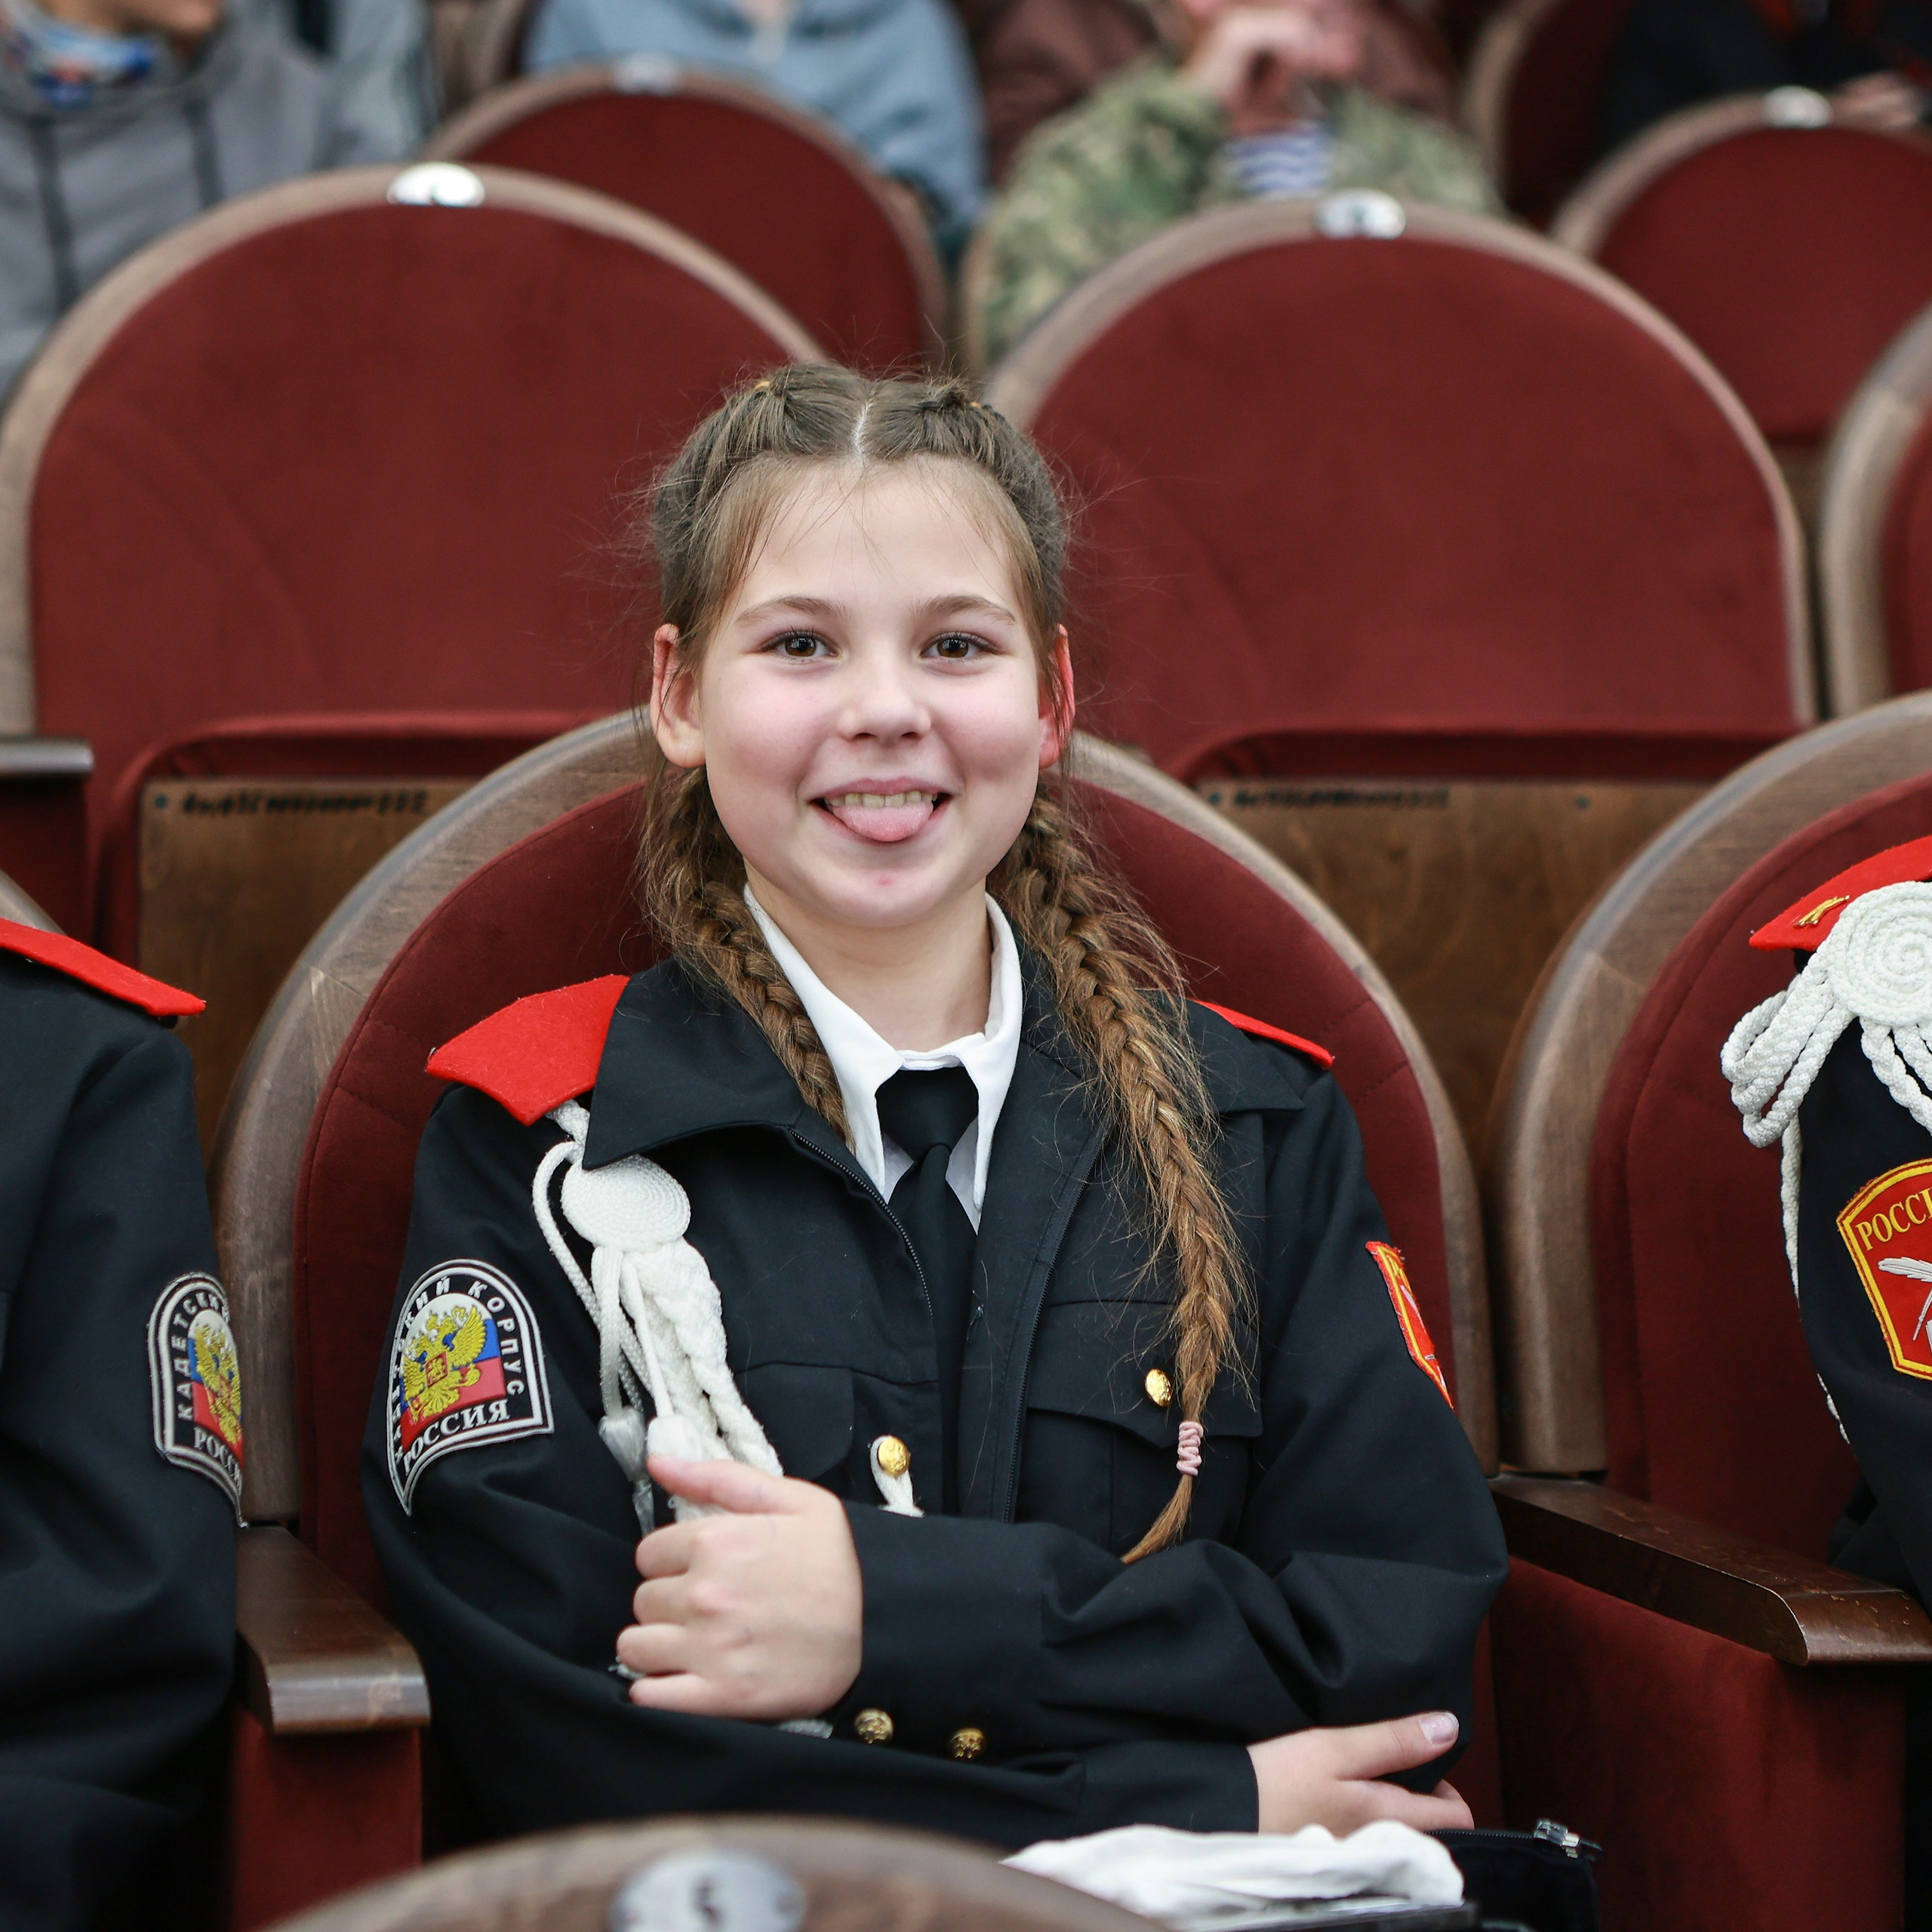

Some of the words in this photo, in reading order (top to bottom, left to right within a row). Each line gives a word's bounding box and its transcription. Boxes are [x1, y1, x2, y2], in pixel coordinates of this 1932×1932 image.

[468, 1280, 525, 1396] КОРПУС
[193, 1426, 242, 1497] РОССИ
[403, 1398, 511, 1476] РОССИЯ
